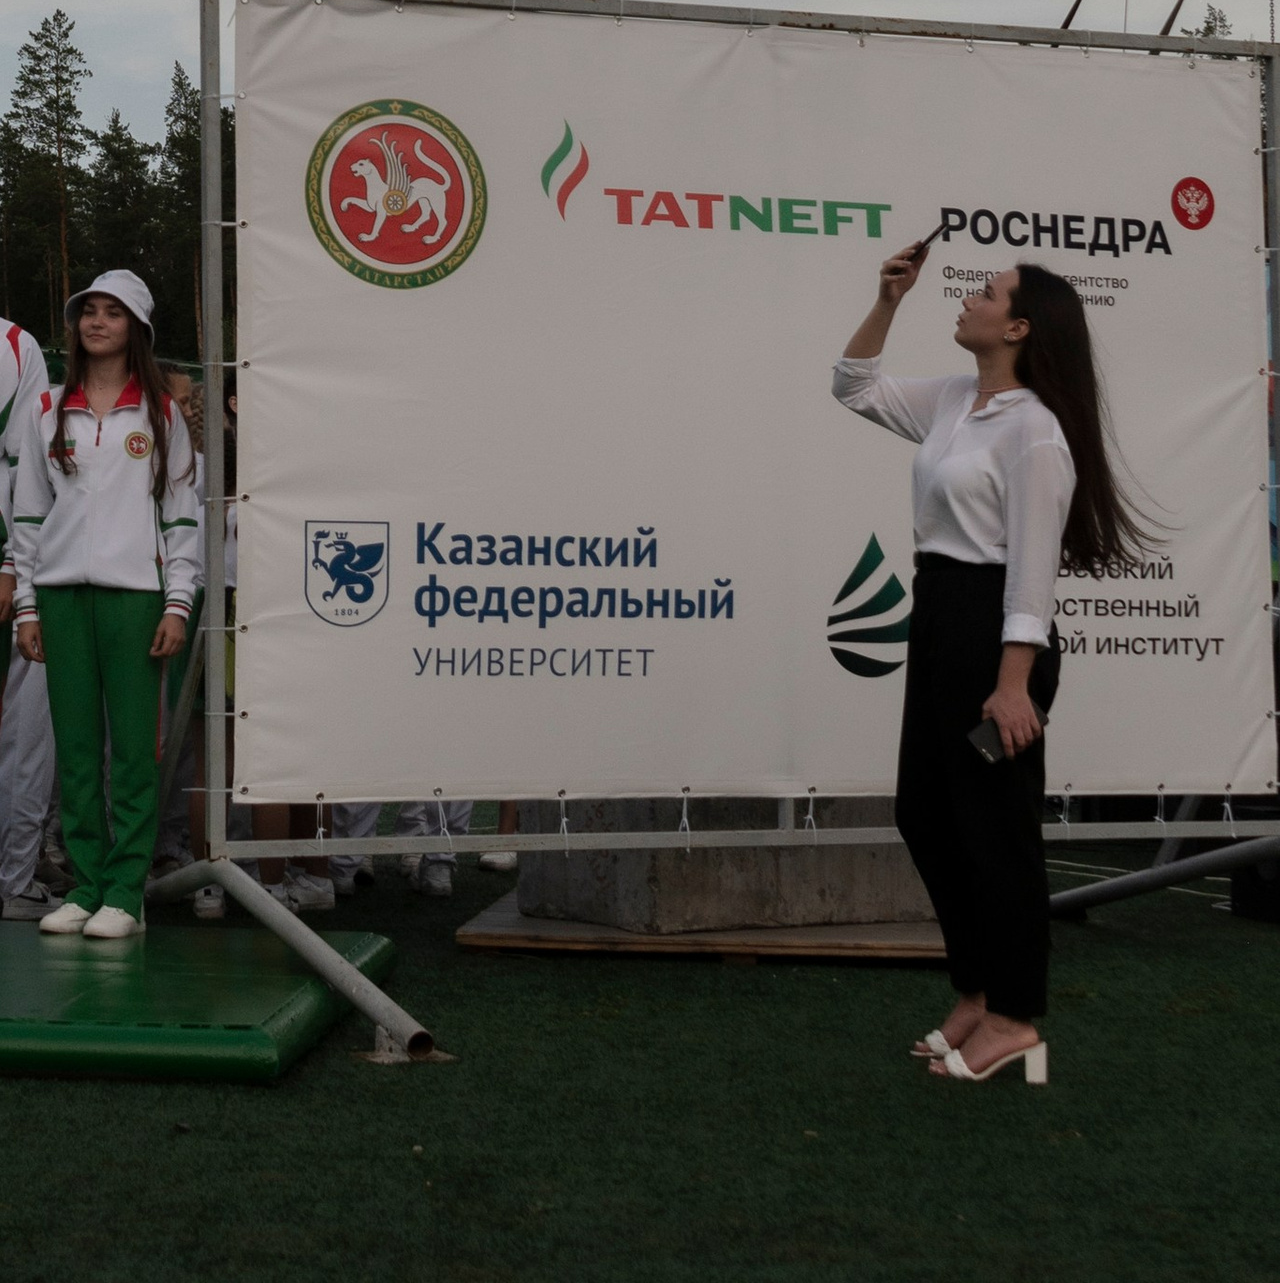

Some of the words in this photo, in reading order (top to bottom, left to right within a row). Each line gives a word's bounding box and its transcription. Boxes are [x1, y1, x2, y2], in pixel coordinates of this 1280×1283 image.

[604, 188, 892, 238] TATNEFT
[941, 207, 1172, 258] РОСНЕДРА
[353, 264, 446, 286] ТАТАРСТАН
[944, 286, 963, 299] по
[416, 522, 657, 568] Казанский
[334, 608, 360, 616] 1804
[414, 574, 734, 628] федеральный
[412, 647, 655, 677] УНИВЕРСИТЕТ
[1096, 637, 1225, 662] институт
